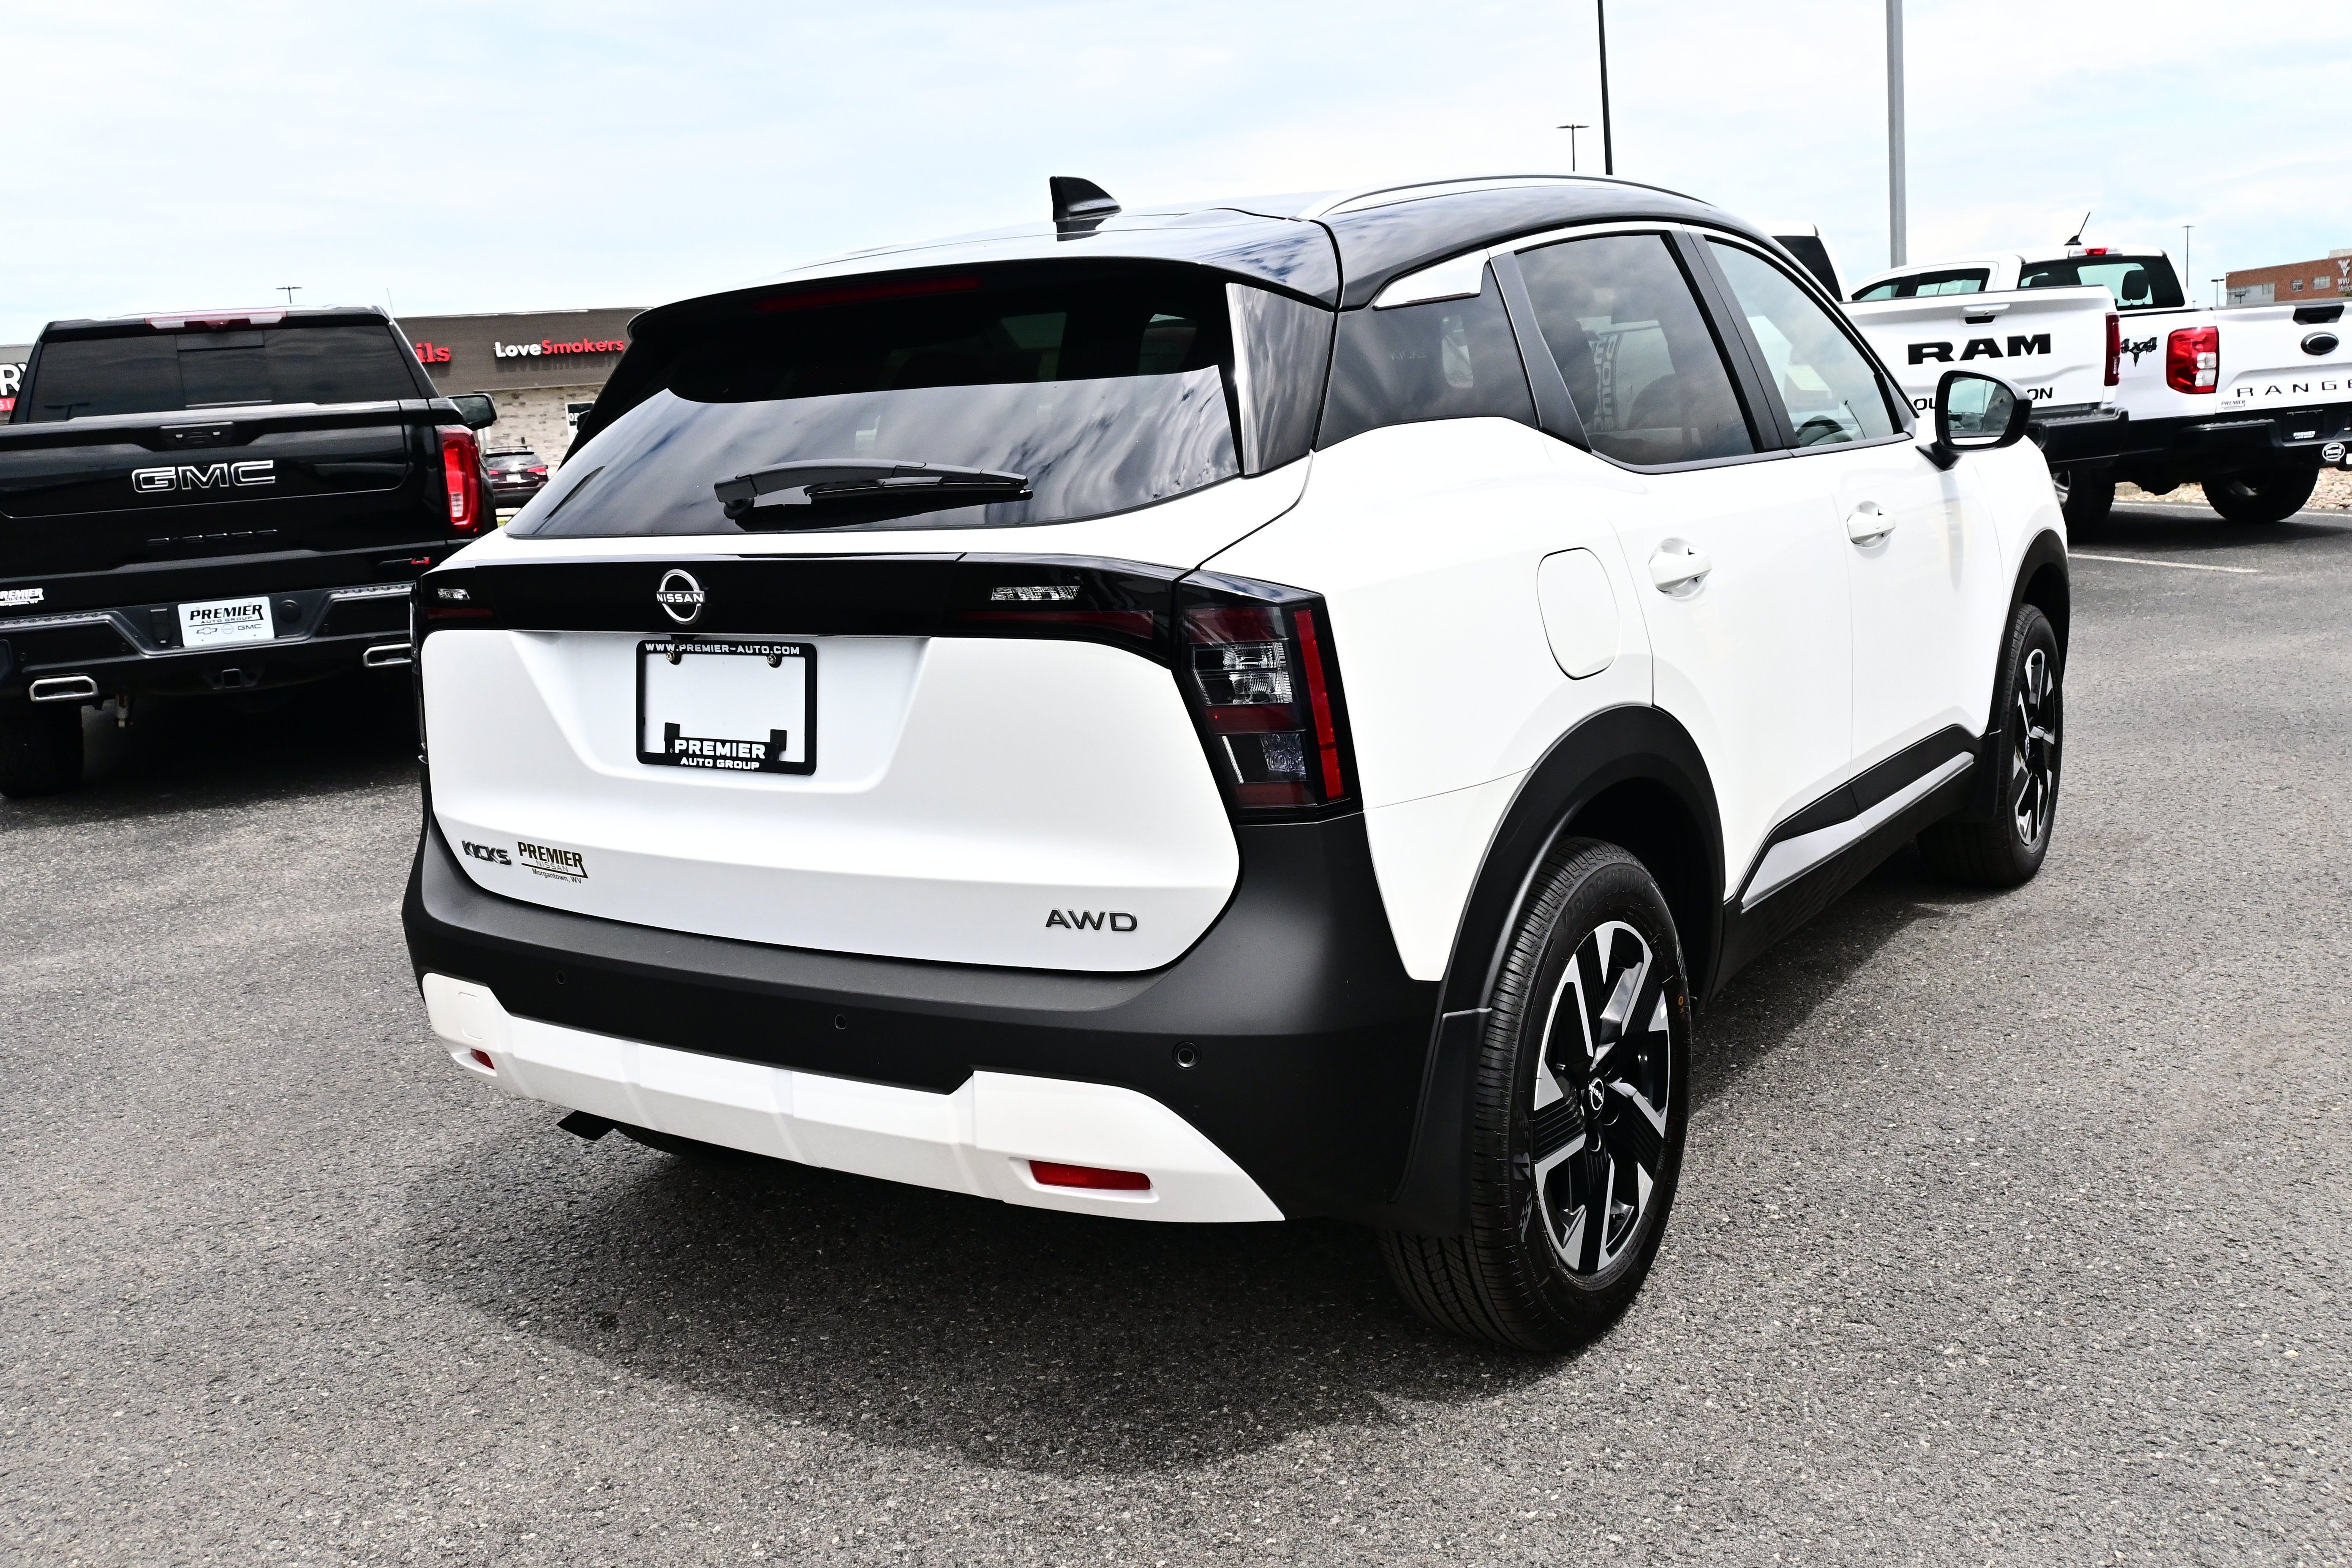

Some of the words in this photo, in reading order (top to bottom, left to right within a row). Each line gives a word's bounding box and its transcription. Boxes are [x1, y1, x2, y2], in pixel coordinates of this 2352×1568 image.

[1908, 333, 2051, 365] RAM
[132, 460, 275, 493] GMC
[656, 593, 704, 603] NISSAN
[190, 604, 264, 621] PREMIER
[645, 643, 799, 654] WWW.PREMIER-AUTO.COM
[675, 739, 765, 759] PREMIER
[680, 757, 713, 767] AUTO
[716, 760, 760, 770] GROUP
[461, 840, 512, 866] KICKS
[517, 841, 584, 869] PREMIER
[536, 860, 568, 872] NISSAN
[532, 868, 570, 883] Morgantown,
[571, 876, 581, 884] WV
[1045, 908, 1138, 931] AWD
